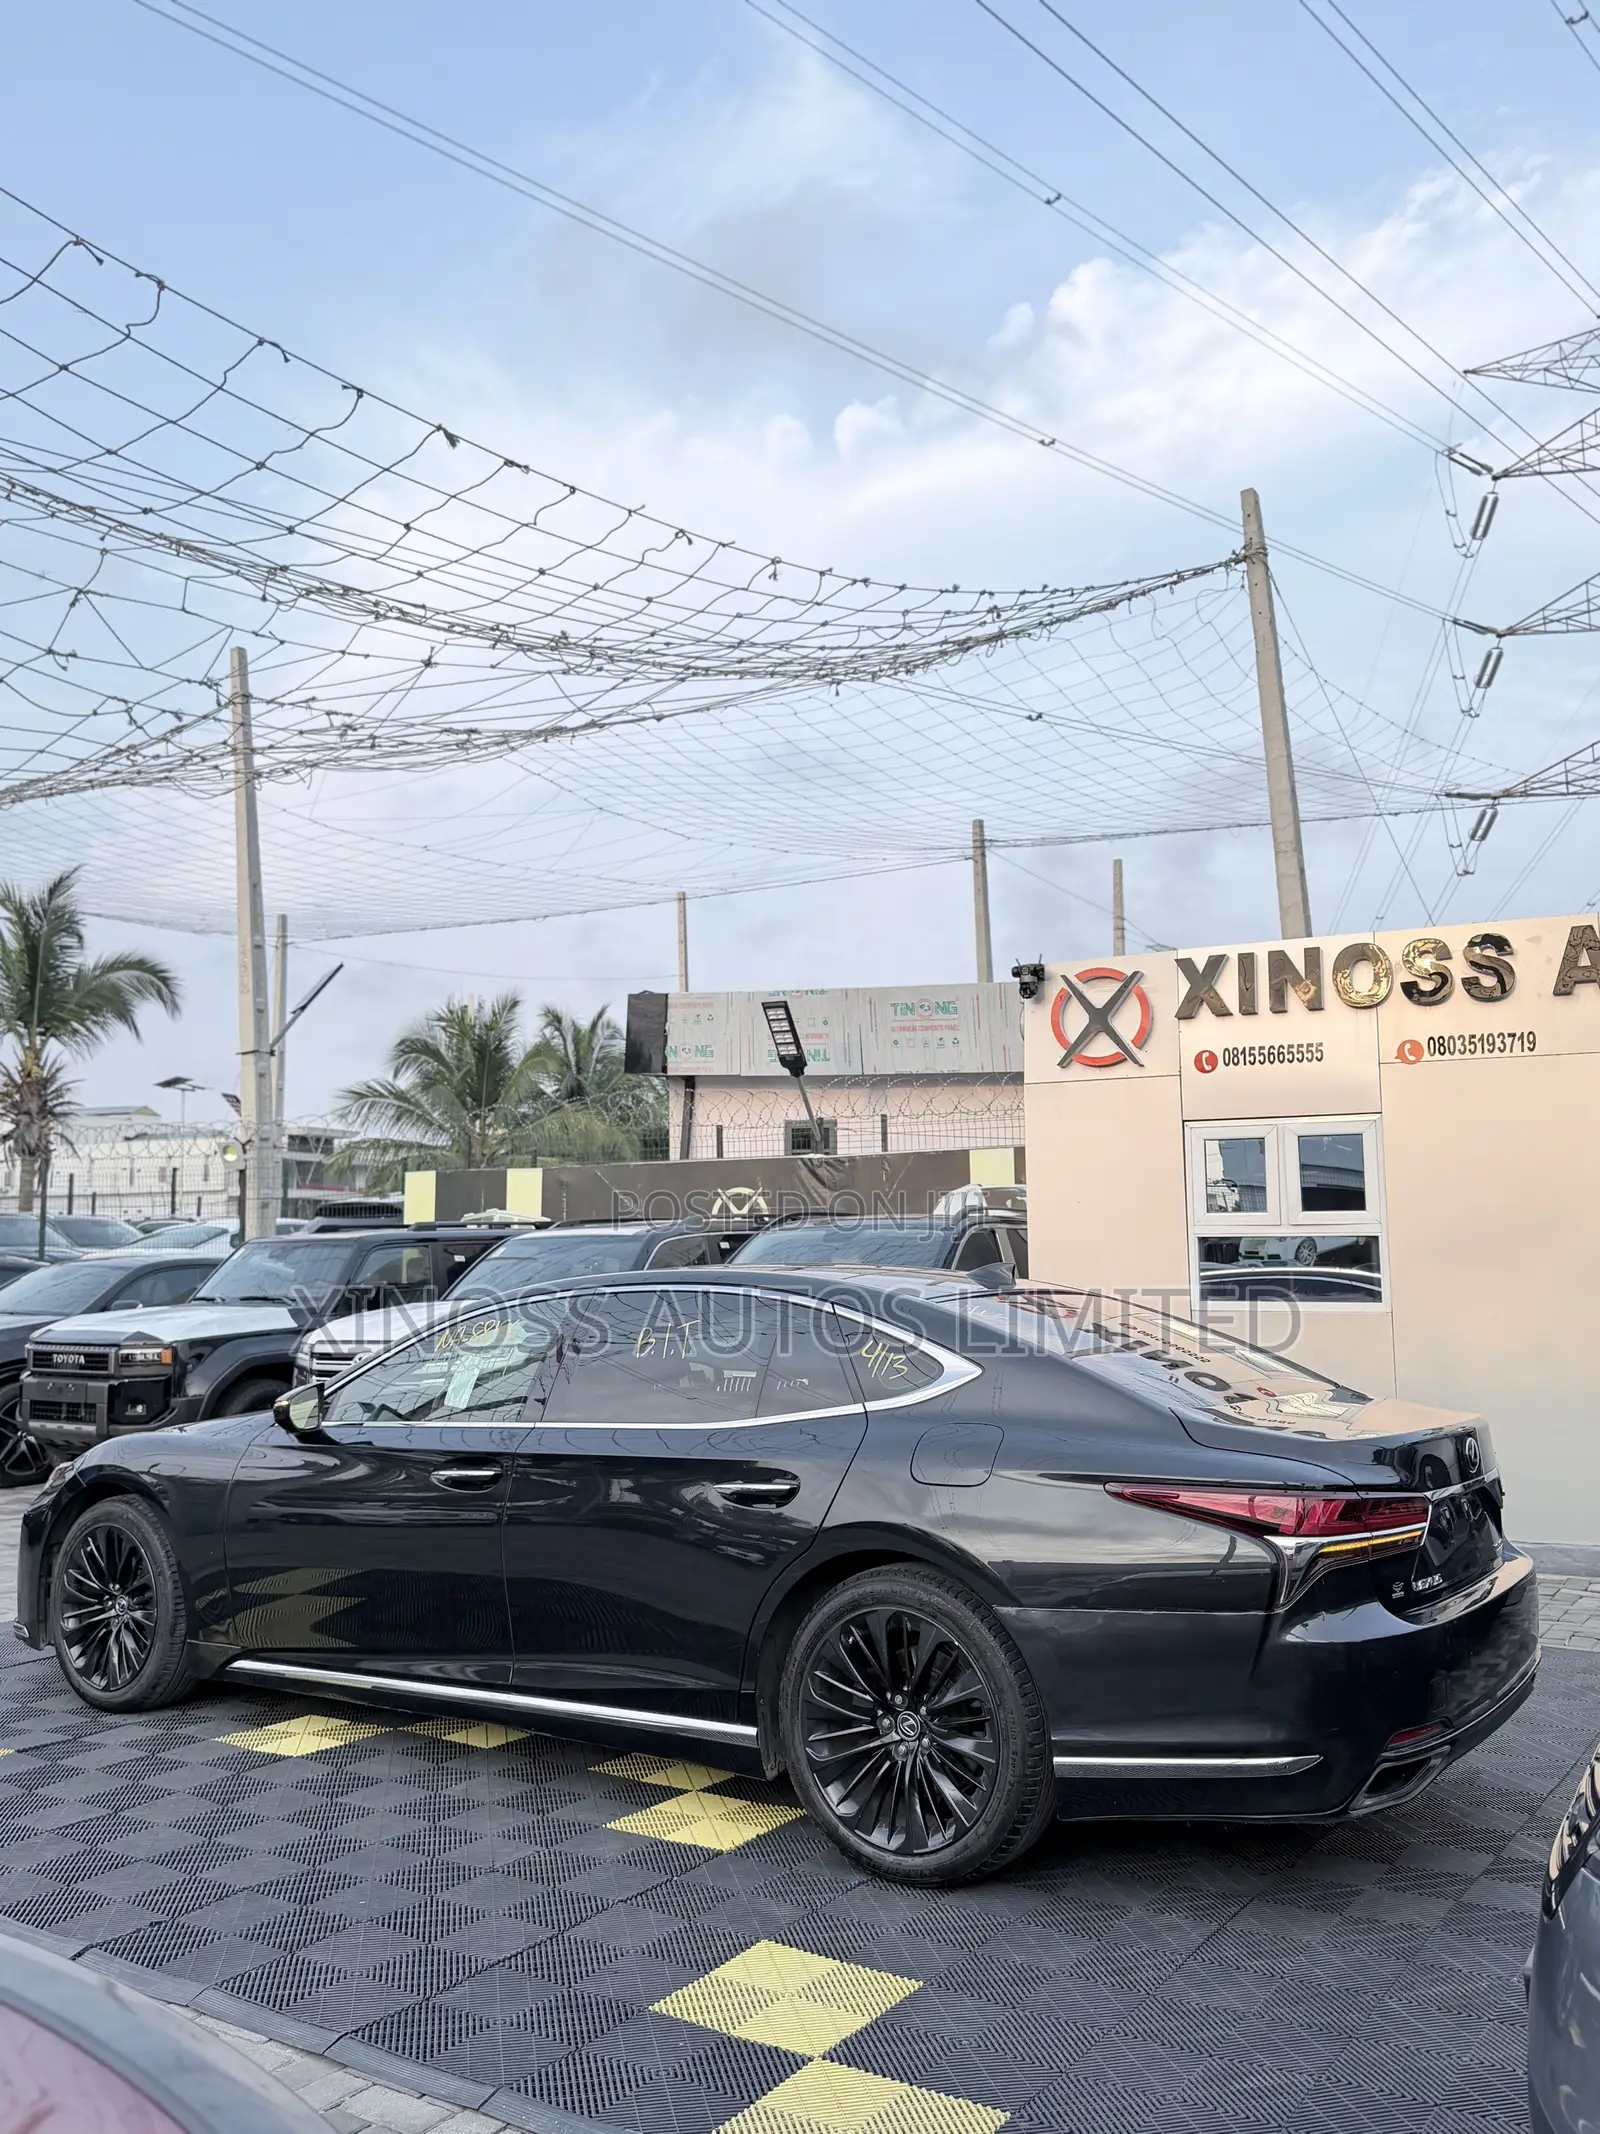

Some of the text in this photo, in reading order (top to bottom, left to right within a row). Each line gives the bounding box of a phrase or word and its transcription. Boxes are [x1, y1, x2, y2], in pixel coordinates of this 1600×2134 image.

[1174, 932, 1516, 1020] XINOSS
[1222, 1042, 1324, 1067] 08155665555
[1427, 1030, 1537, 1057] 08035193719
[52, 1353, 86, 1365] TOYOTA
